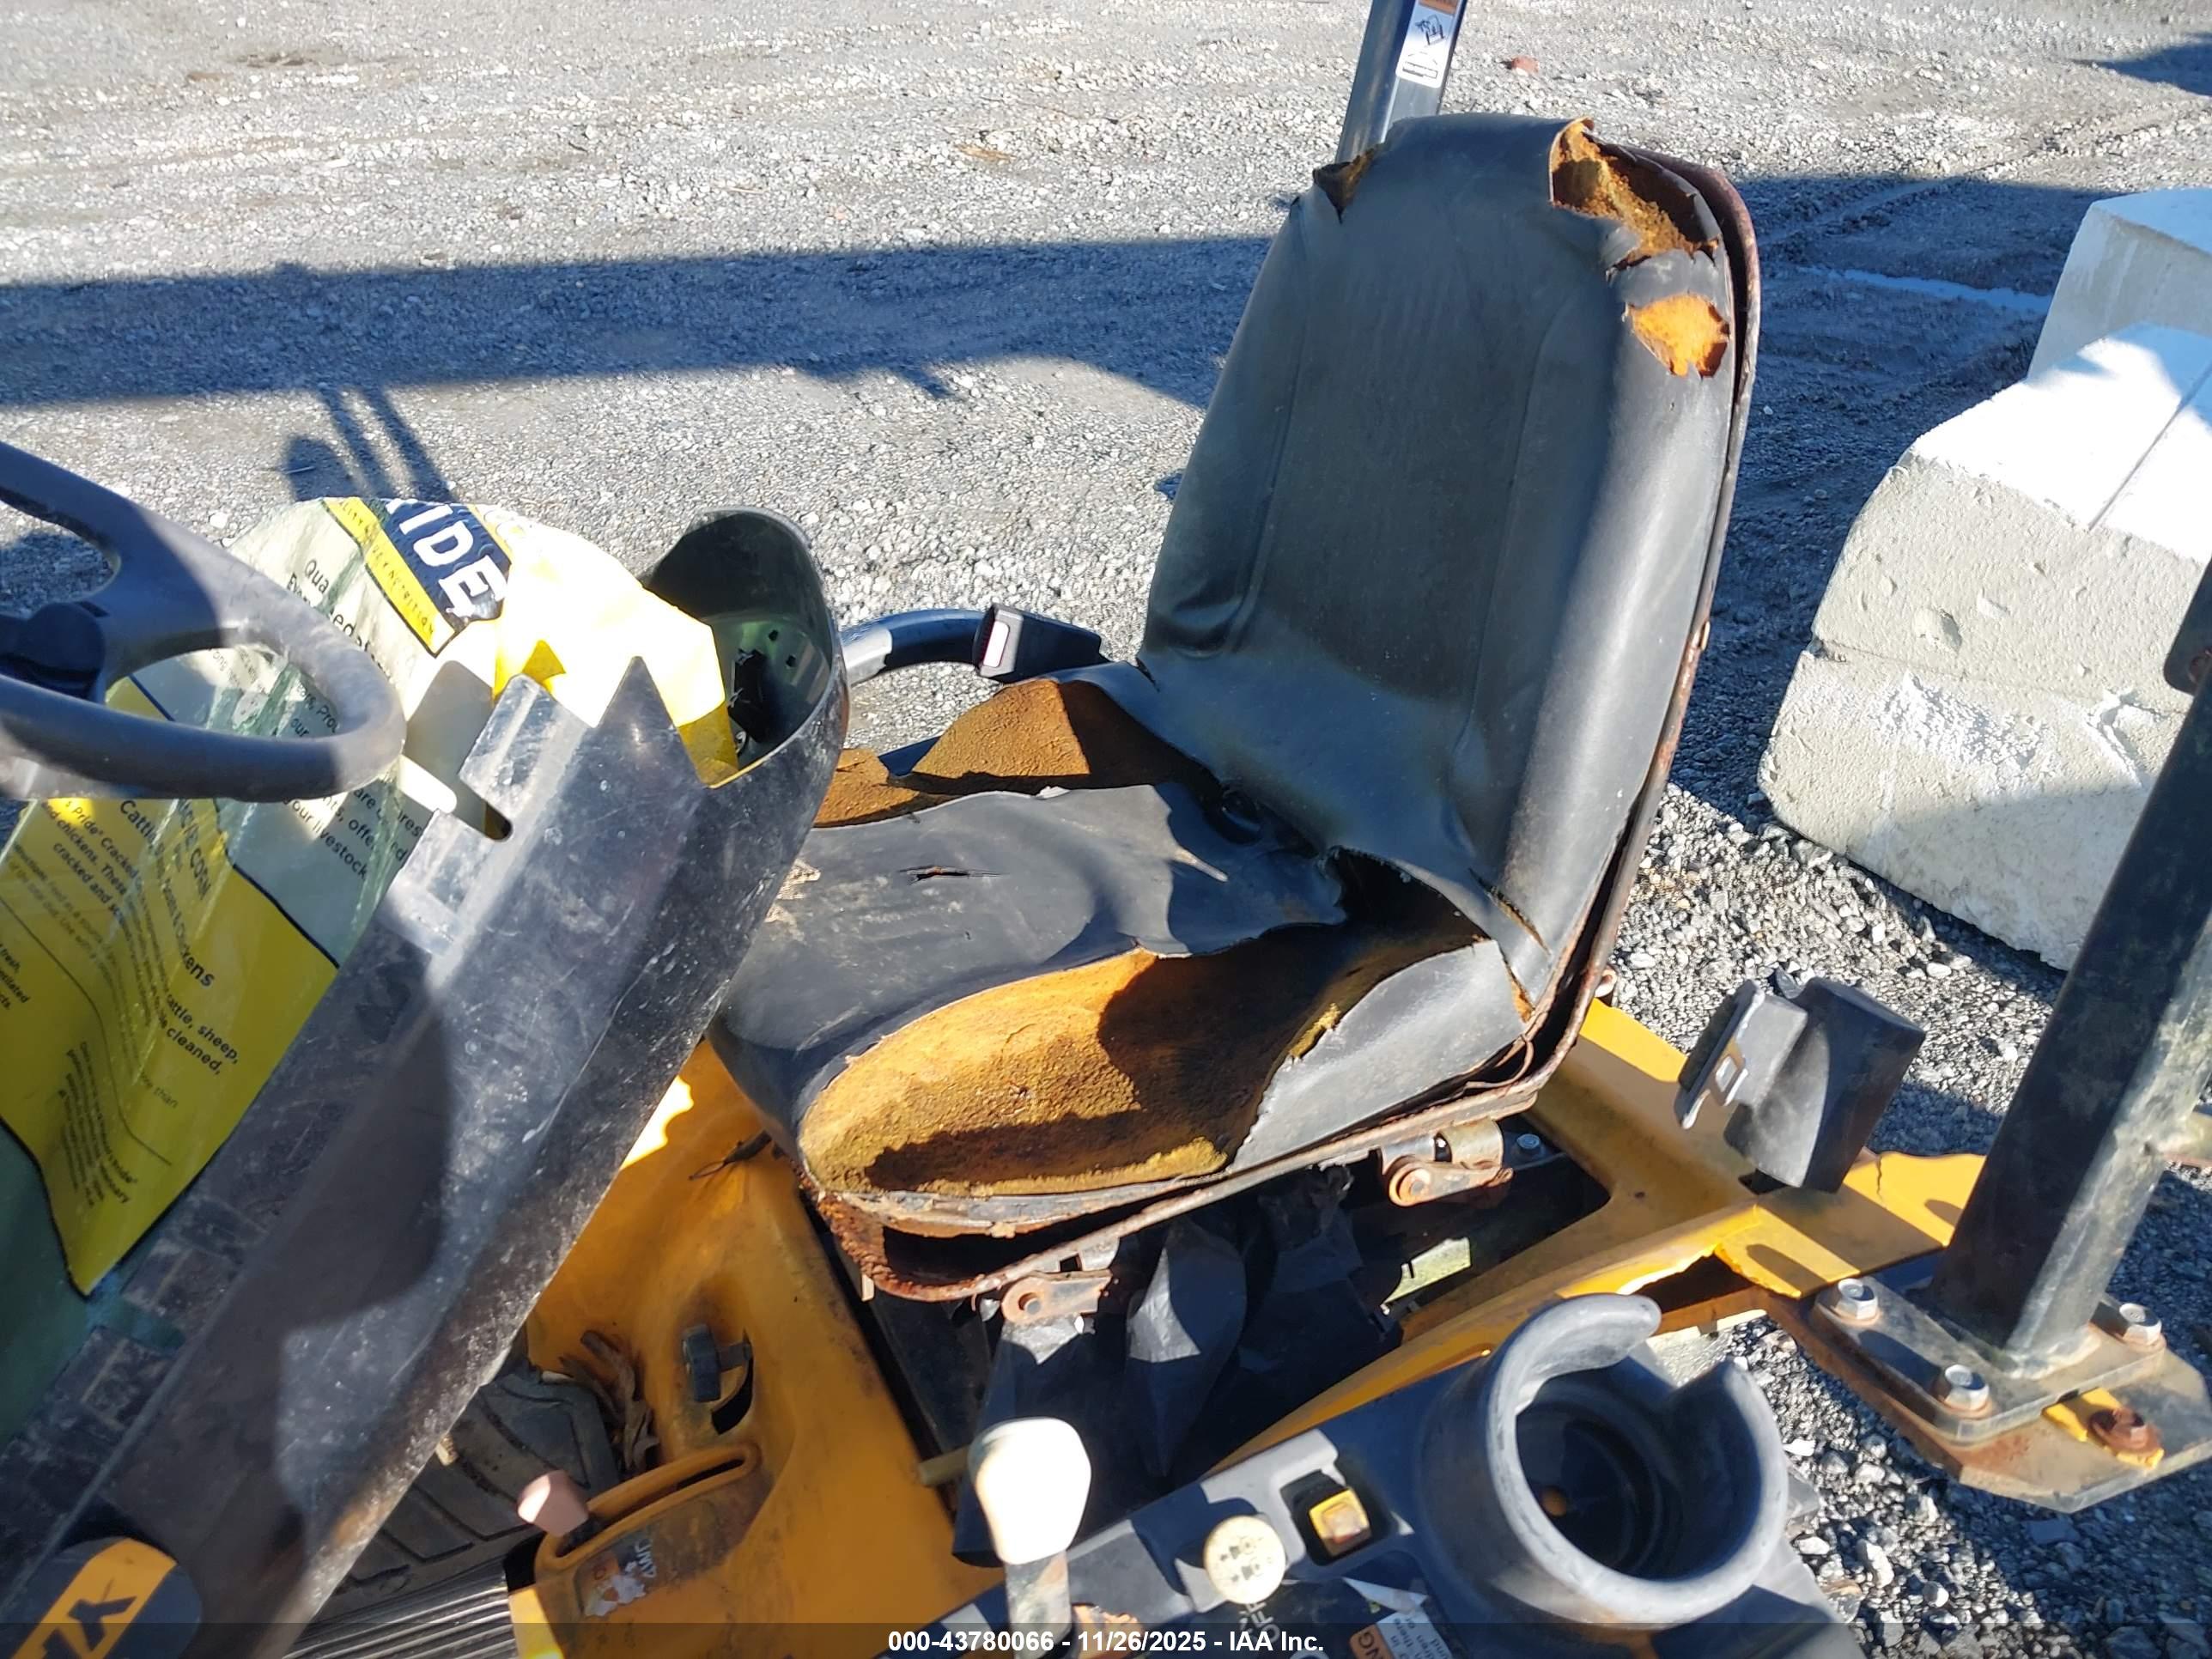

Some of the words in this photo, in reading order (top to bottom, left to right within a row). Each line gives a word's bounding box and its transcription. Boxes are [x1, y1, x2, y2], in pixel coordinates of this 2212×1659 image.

[386, 498, 507, 618] IDE
[52, 842, 94, 884] cracked
[166, 1028, 222, 1075] cleaned,
[198, 1025, 238, 1064] sheep,
